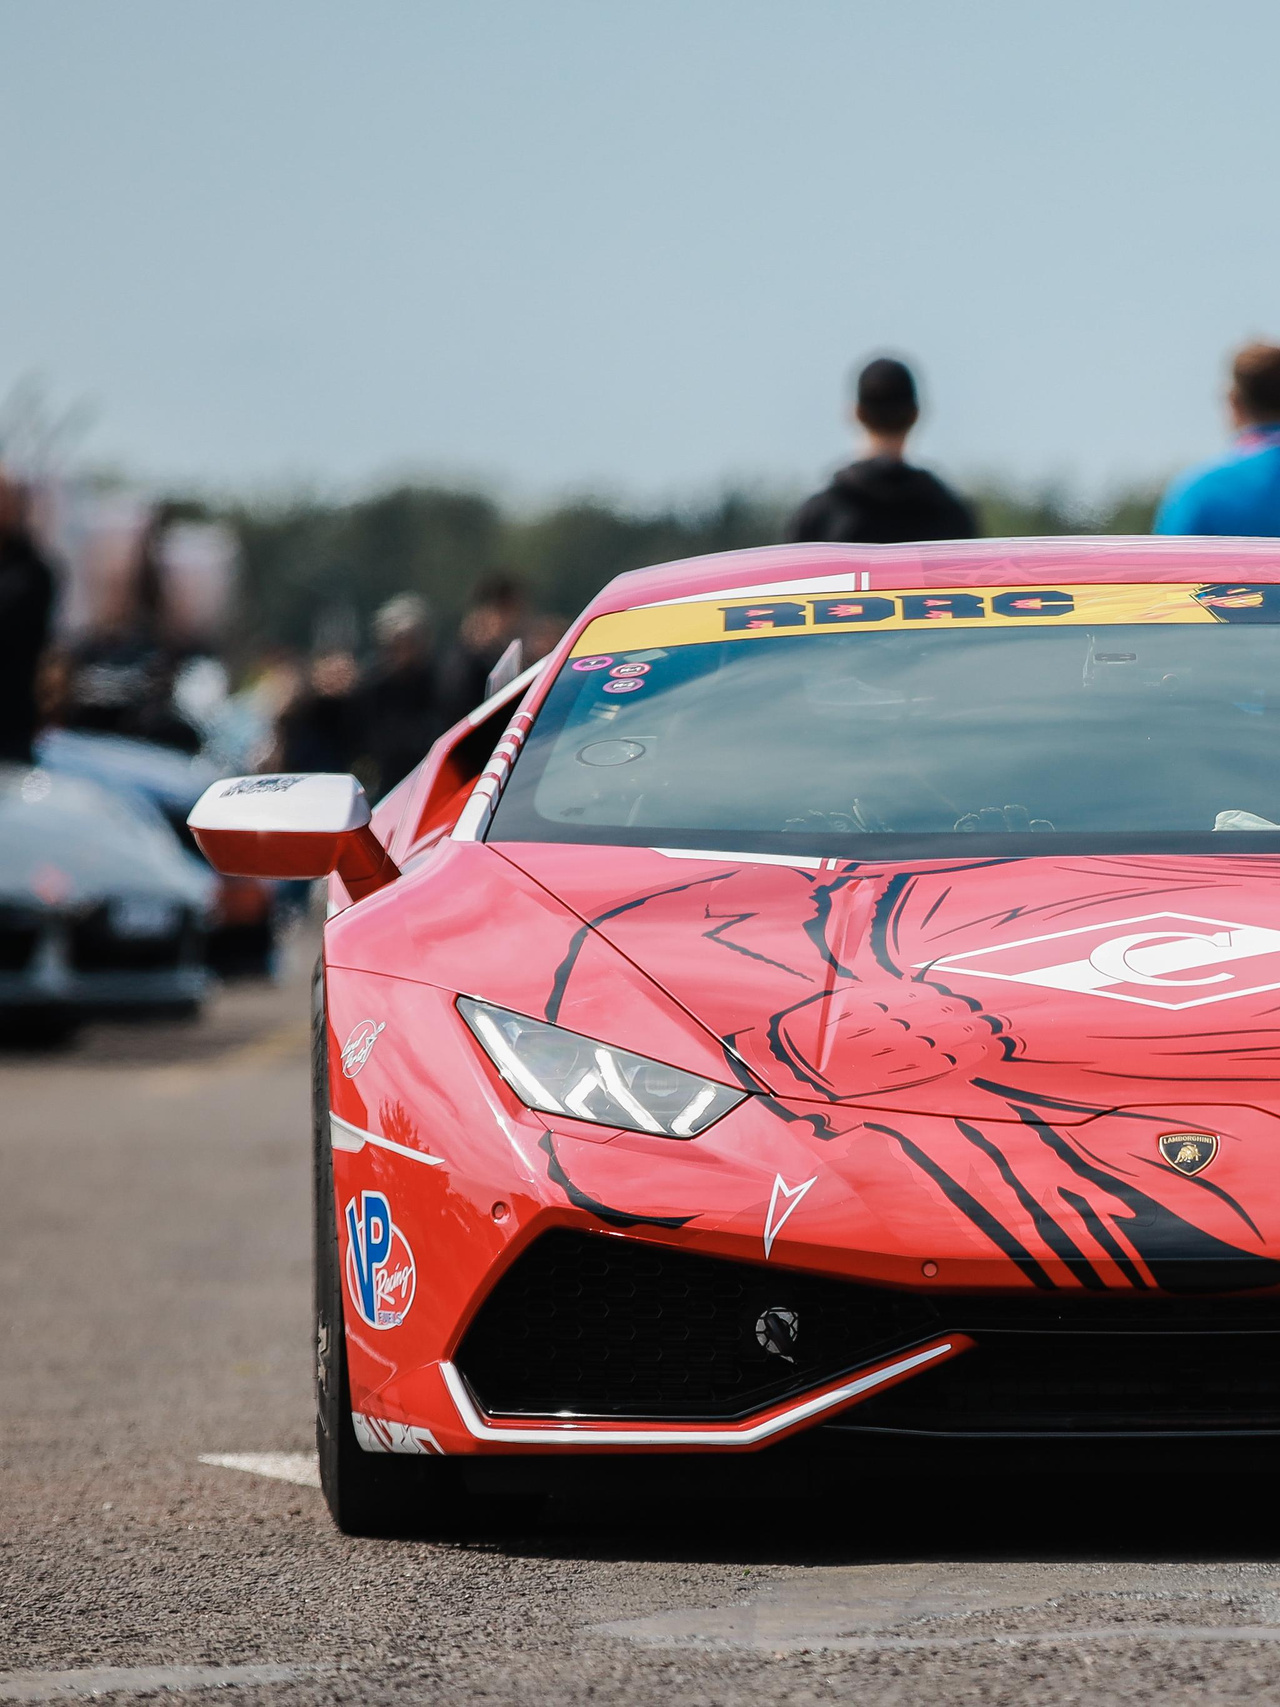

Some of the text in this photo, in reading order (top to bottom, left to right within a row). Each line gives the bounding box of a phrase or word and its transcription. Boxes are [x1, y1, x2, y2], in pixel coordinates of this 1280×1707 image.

[718, 590, 1075, 632] RDRC
[1163, 1136, 1212, 1145] LAMBORGHINI
[345, 1190, 393, 1324] VP
[376, 1263, 413, 1309] Racing
